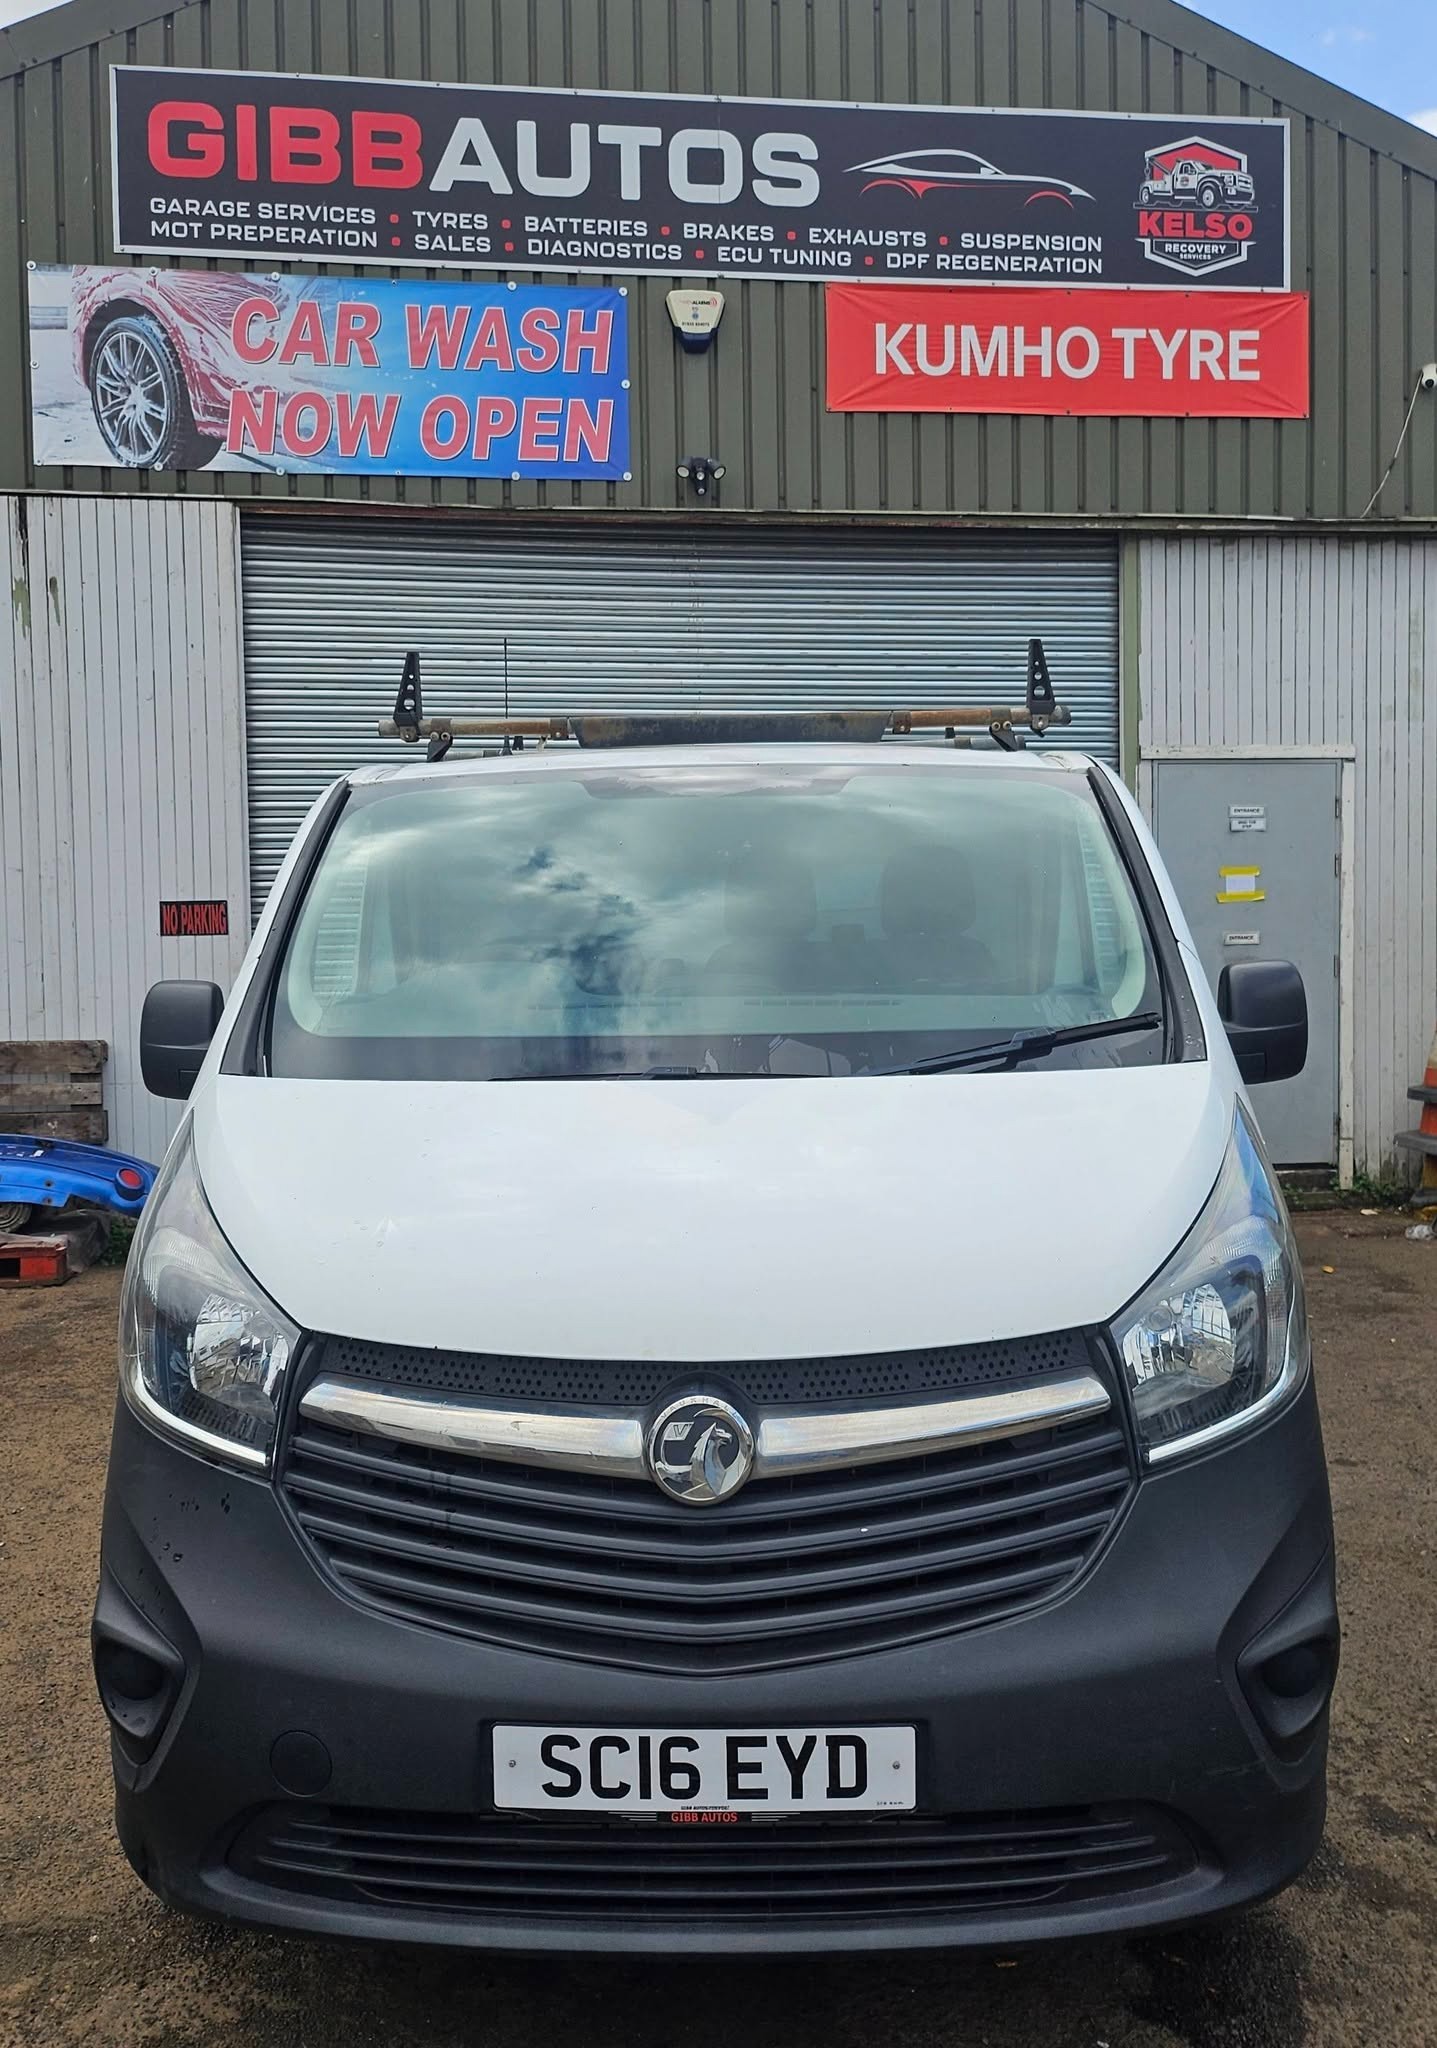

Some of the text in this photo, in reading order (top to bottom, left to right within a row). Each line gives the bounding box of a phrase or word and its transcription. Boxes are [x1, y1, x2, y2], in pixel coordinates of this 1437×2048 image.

[150, 197, 1102, 252] GARAGE SERVICES TYRES BATTERIES BRAKES EXHAUSTS SUSPENSION
[151, 221, 1102, 273] MOT PREPERATION SALES DIAGNOSTICS ECU TUNING DPF REGENERATION
[1139, 210, 1253, 240] KELSO
[1165, 243, 1226, 255] RECOVERY
[231, 298, 613, 374] CAR WASH
[875, 323, 1260, 381] KUMHO TYRE
[226, 389, 614, 463] NOW OPEN
[163, 904, 227, 935] NO PARKING
[540, 1734, 868, 1800] SC16 EYD
[671, 1812, 738, 1823] GIBB AUTOS
